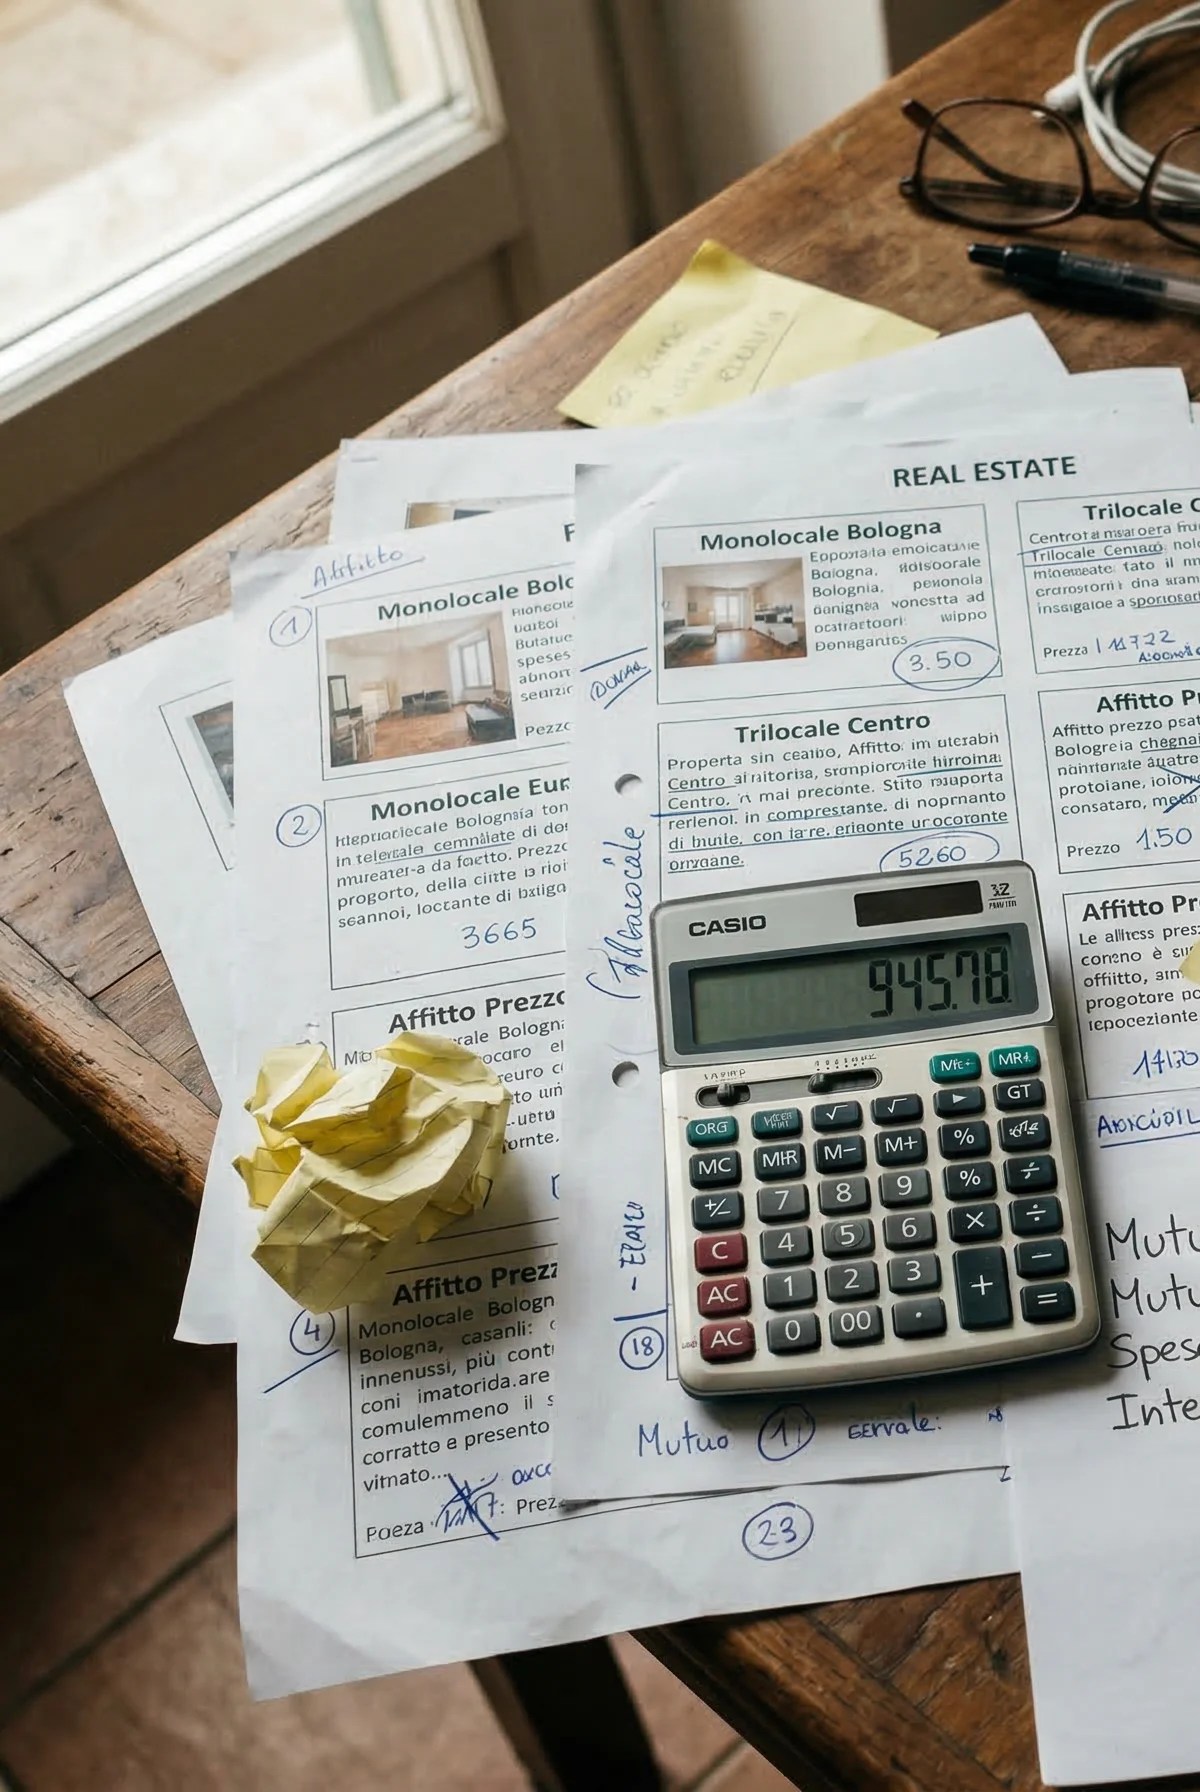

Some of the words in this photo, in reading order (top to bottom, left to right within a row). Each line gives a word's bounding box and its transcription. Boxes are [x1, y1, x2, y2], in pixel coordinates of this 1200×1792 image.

[893, 465, 966, 488] REAL
[974, 456, 1077, 482] ESTATE
[1083, 499, 1183, 520] Trilocale
[700, 524, 840, 551] Monolocale
[847, 519, 942, 540] Bologna
[1165, 557, 1174, 568] il
[377, 584, 520, 621] Monolocale
[966, 591, 985, 603] ad
[909, 650, 972, 672] 3.50
[1097, 692, 1174, 713] Affitto
[734, 719, 840, 743] Trilocale
[847, 714, 931, 734] Centro
[1052, 723, 1104, 738] Affitto
[1109, 719, 1163, 737] prezzo
[667, 755, 742, 771] Properta
[750, 752, 774, 764] sin
[667, 775, 726, 790] Centro
[883, 777, 923, 792] Stito
[370, 783, 521, 821] Monolocale
[745, 812, 760, 824] in
[894, 797, 909, 811] di
[336, 855, 351, 868] in
[522, 825, 538, 841] di
[668, 837, 684, 850] di
[753, 830, 783, 843] con
[1067, 843, 1121, 858] Prezzo
[1136, 826, 1193, 851] 1.50
[431, 858, 451, 873] da
[899, 845, 967, 868] 5260
[426, 876, 467, 893] della
[496, 888, 512, 903] di
[1082, 899, 1164, 922] Affitto
[460, 916, 538, 950] 3665
[688, 914, 767, 938] CASIO
[1079, 933, 1098, 946] Le
[1152, 946, 1163, 960] è
[387, 1003, 476, 1035] Affitto
[1007, 1084, 1032, 1101] GT
[698, 1156, 732, 1176] MC
[885, 1135, 919, 1152] M+
[774, 1189, 791, 1211] 7
[835, 1183, 853, 1203] 8
[896, 1175, 913, 1197] 9
[710, 1241, 729, 1261] C
[776, 1230, 795, 1254] 4
[839, 1223, 857, 1246] 5
[901, 1217, 918, 1239] 6
[392, 1275, 483, 1306] Affitto
[706, 1283, 740, 1305] AC
[783, 1275, 794, 1295] 1
[844, 1268, 861, 1290] 2
[906, 1260, 923, 1282] 3
[358, 1306, 474, 1339] Monolocale
[710, 1327, 743, 1348] AC
[784, 1319, 801, 1342] 0
[839, 1309, 872, 1332] 00
[359, 1339, 444, 1365] Bologna,
[633, 1335, 655, 1357] 18
[360, 1358, 457, 1390] innenussi,
[466, 1350, 496, 1374] più
[361, 1393, 401, 1415] coni
[361, 1402, 509, 1440] comulemmeno
[523, 1394, 533, 1411] il
[362, 1440, 441, 1466] corratto
[465, 1420, 550, 1451] presento
[637, 1423, 730, 1458] Mutuo
